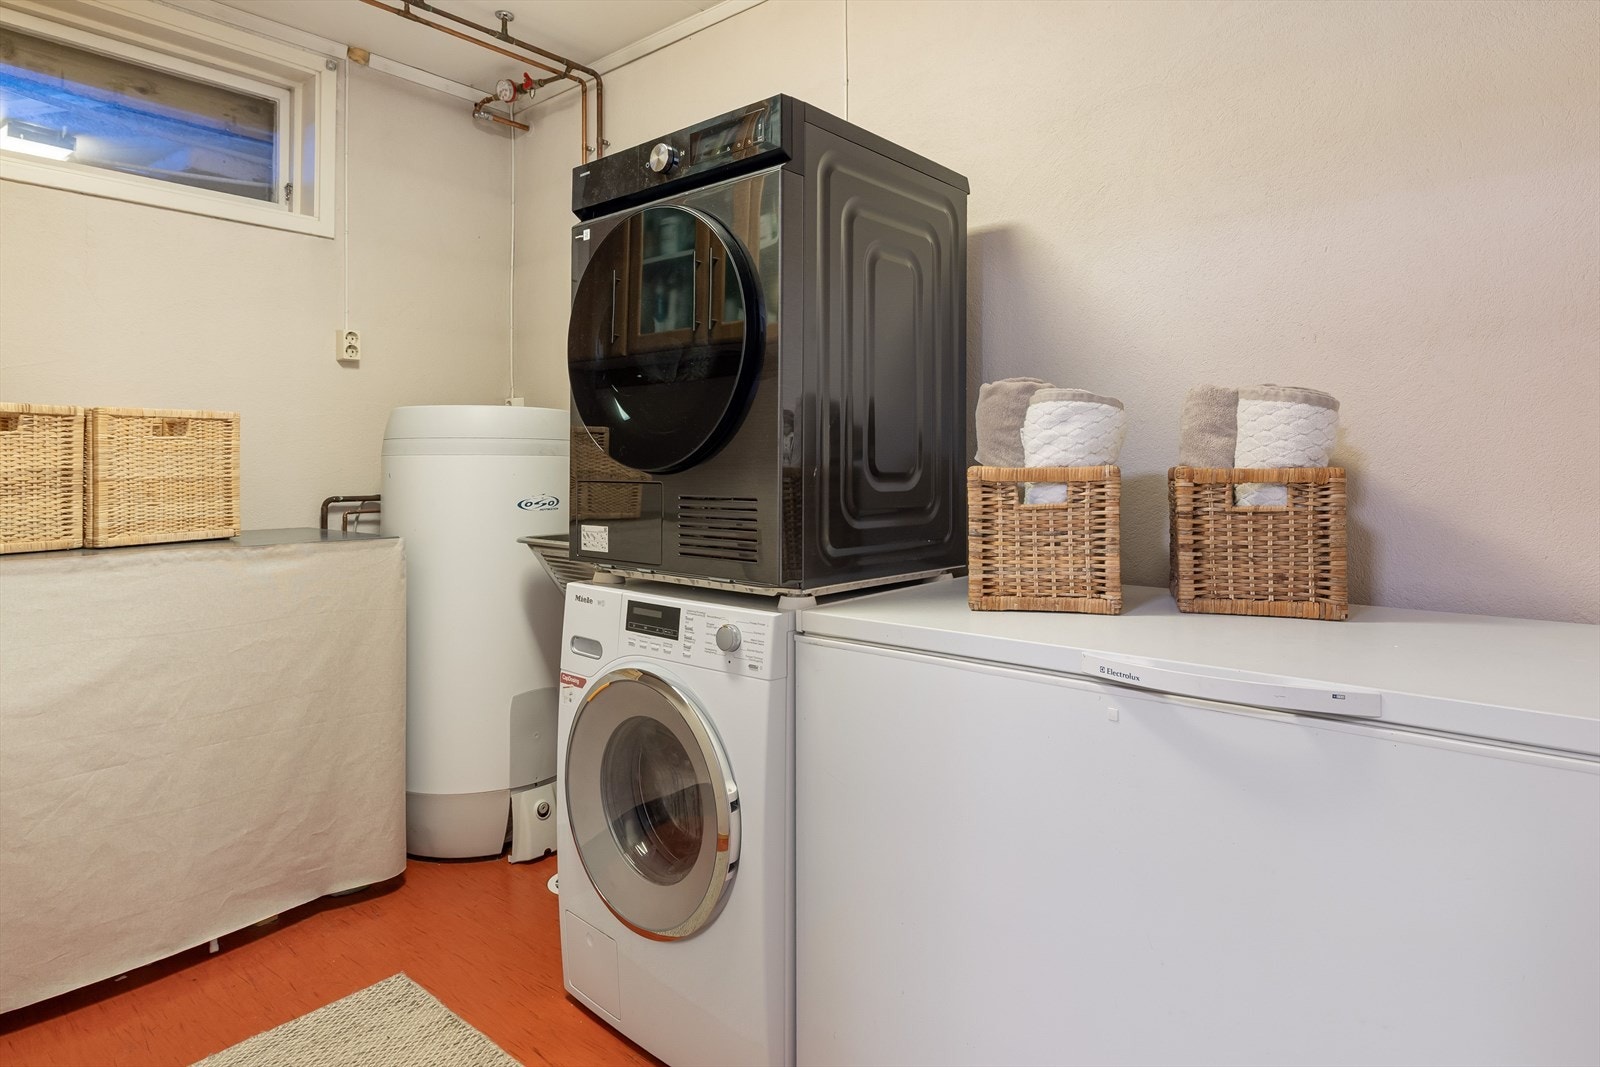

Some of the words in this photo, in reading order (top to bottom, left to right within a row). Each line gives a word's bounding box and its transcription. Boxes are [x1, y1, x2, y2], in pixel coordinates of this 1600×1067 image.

[517, 495, 560, 510] OSO
[575, 594, 594, 605] Miele
[1106, 667, 1140, 682] Electrolux
